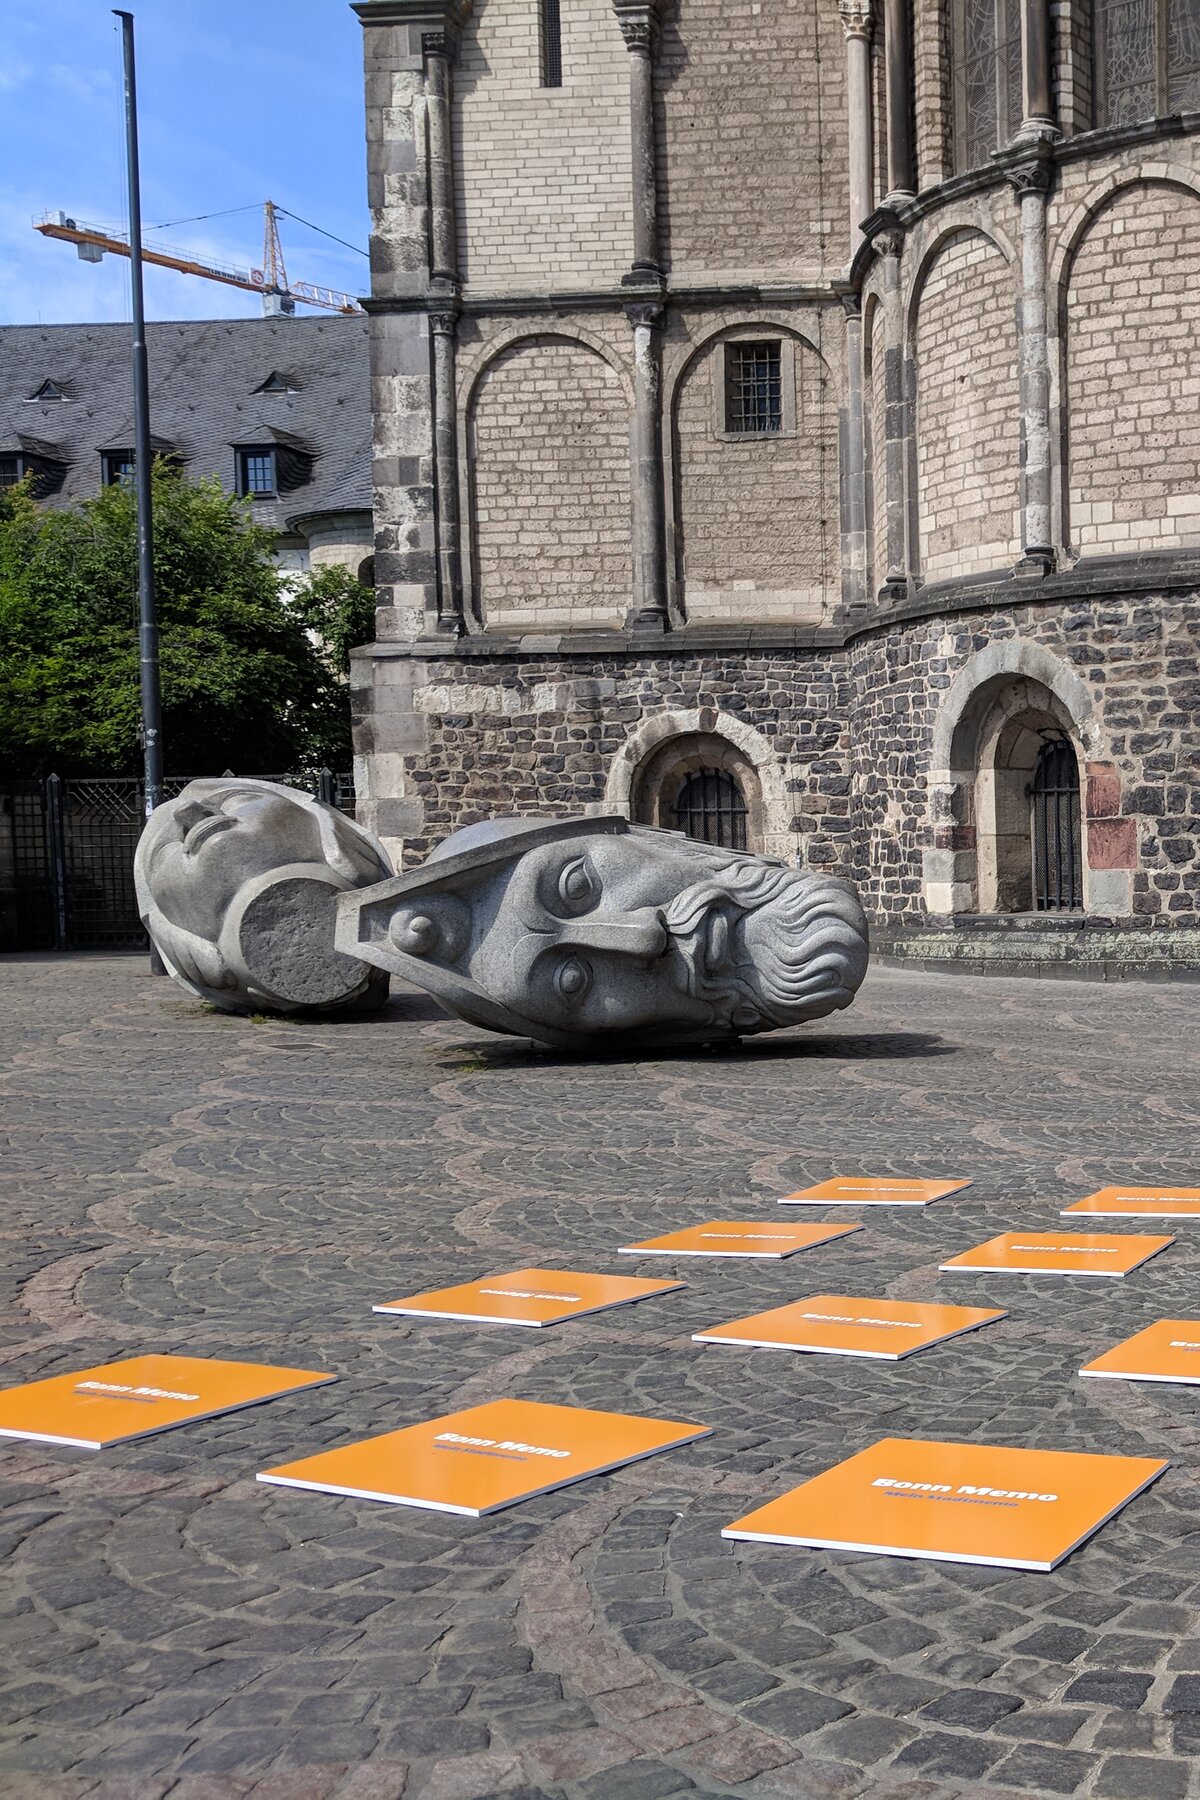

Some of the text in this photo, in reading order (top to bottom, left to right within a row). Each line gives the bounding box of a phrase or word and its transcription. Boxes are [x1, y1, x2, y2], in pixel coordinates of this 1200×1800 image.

[433, 1432, 497, 1447] Bonn
[493, 1440, 572, 1458] Memo
[870, 1477, 1058, 1502] Bonn Memo
